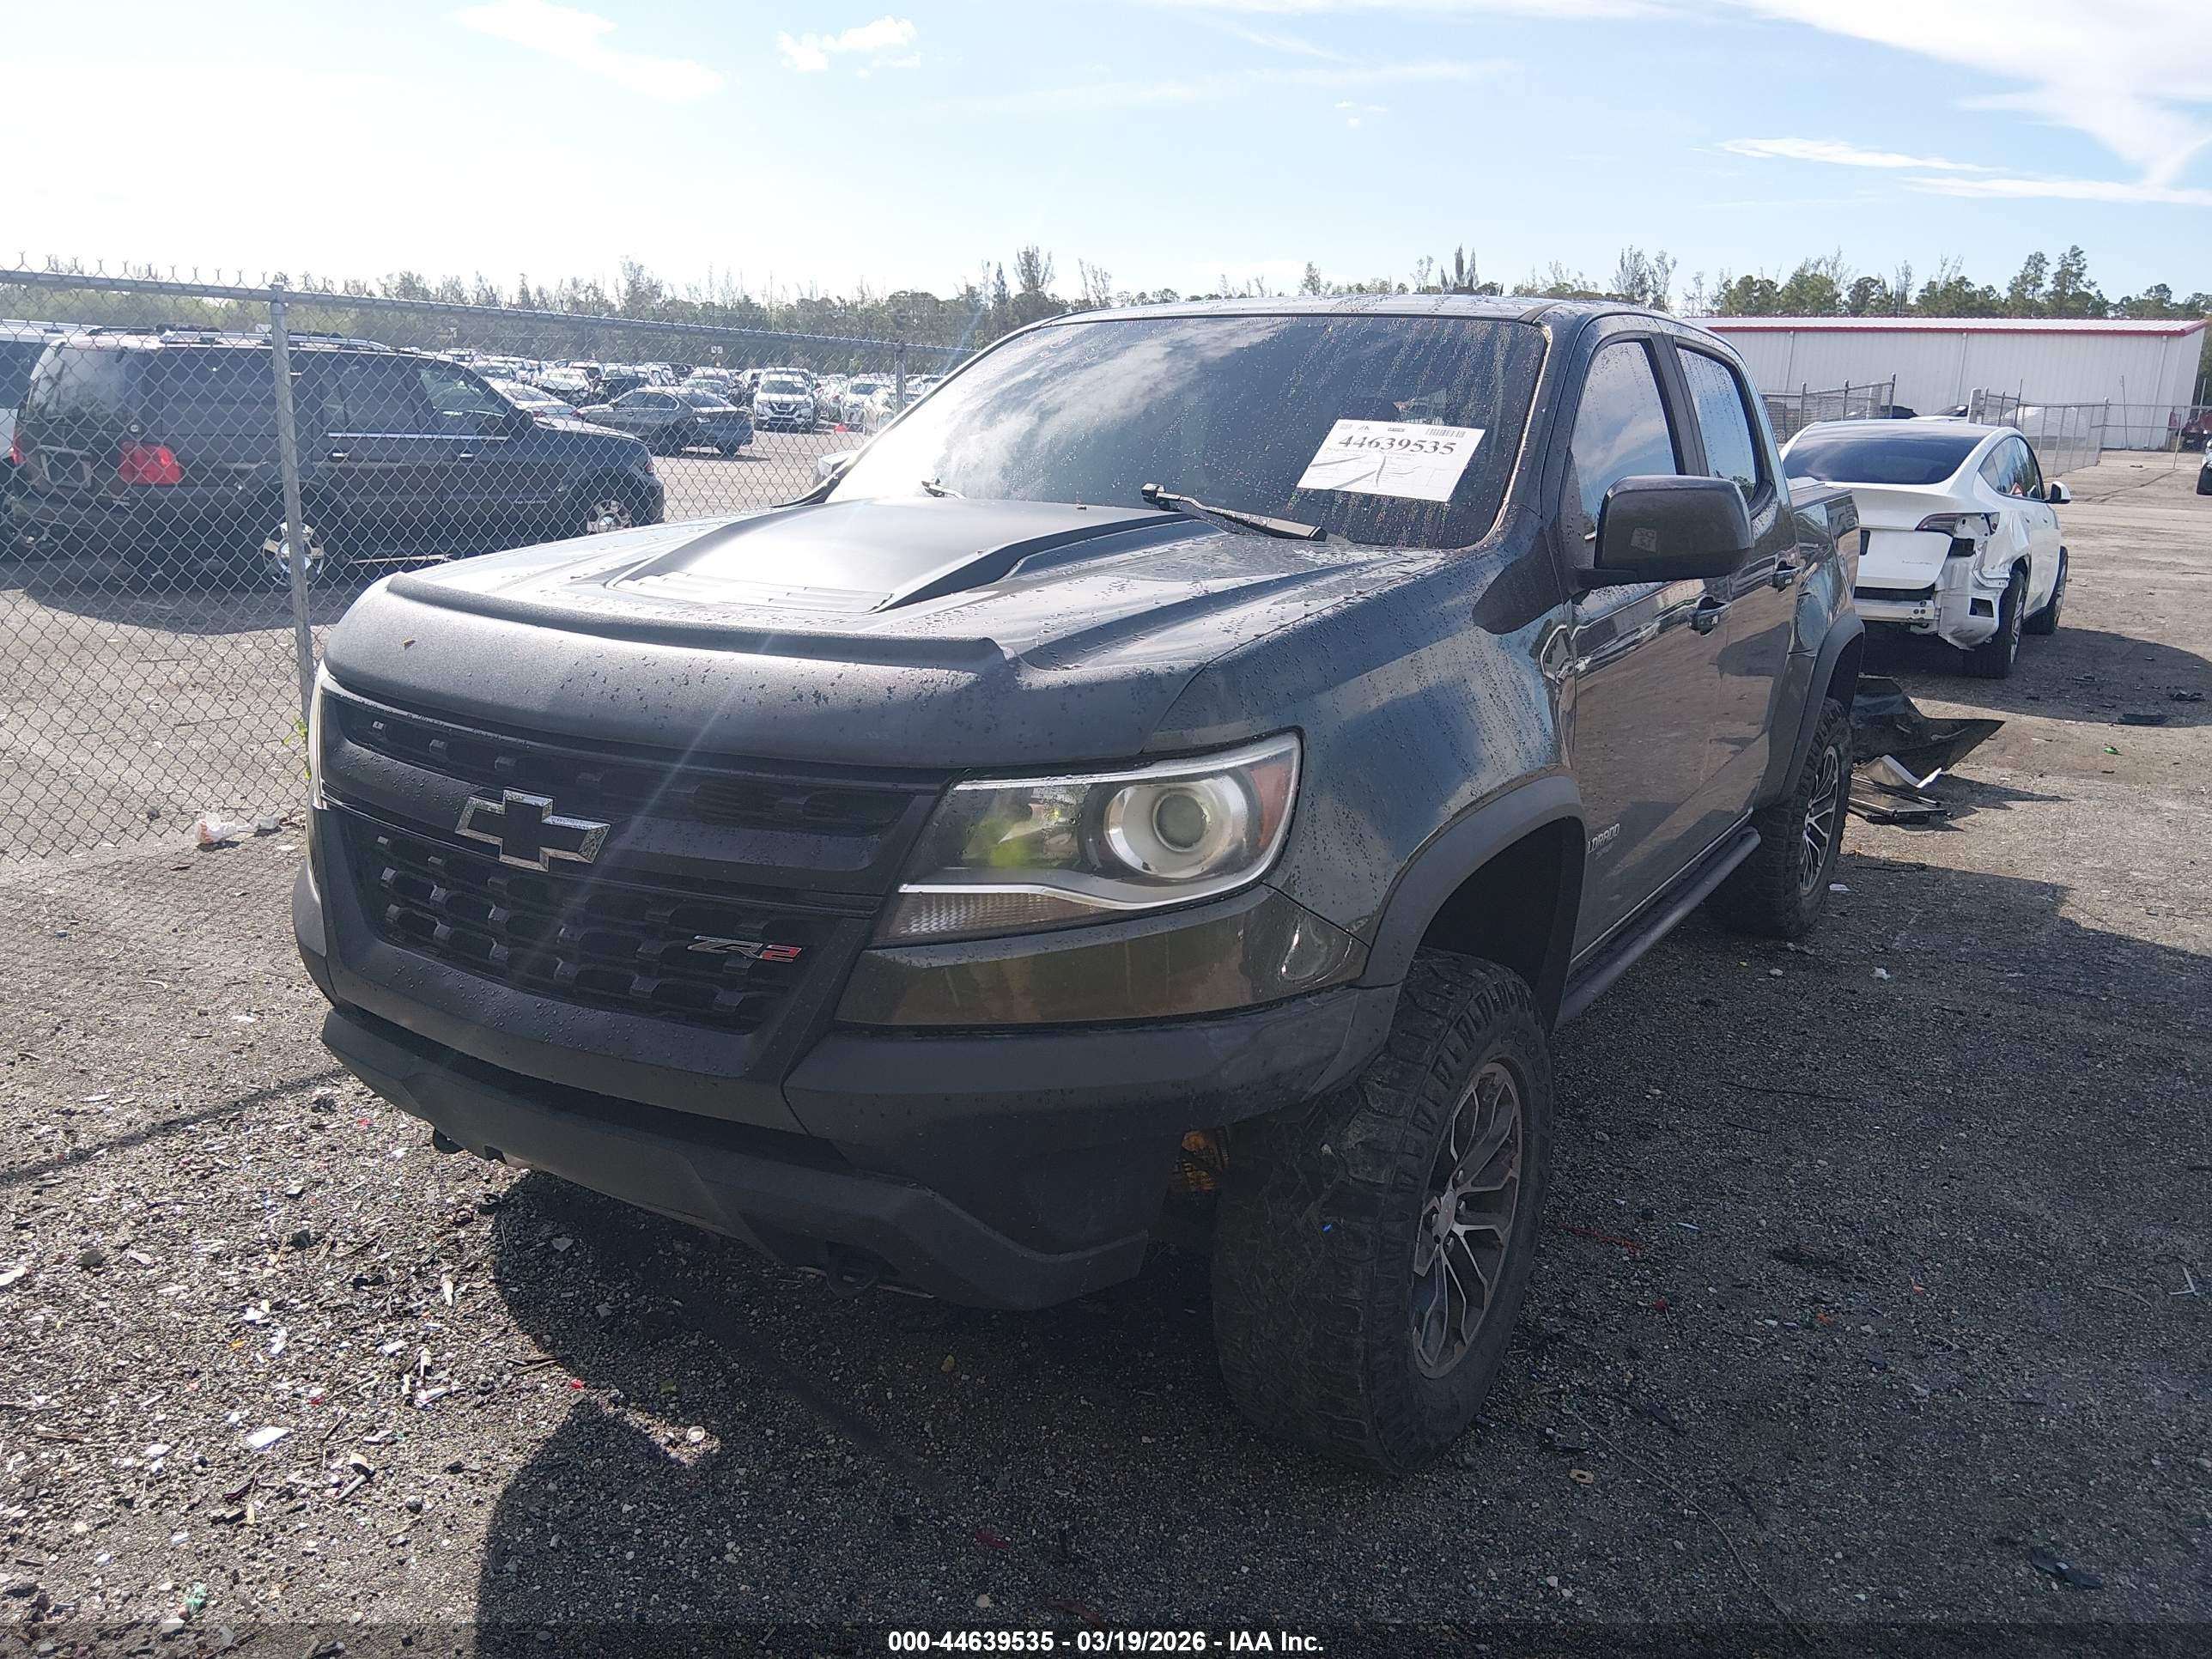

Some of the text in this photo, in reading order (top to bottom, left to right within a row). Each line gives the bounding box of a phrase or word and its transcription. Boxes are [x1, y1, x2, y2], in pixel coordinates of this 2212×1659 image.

[1338, 434, 1457, 456] 44639535
[1587, 822, 1620, 854] LORADO
[686, 934, 804, 963] ZR2
